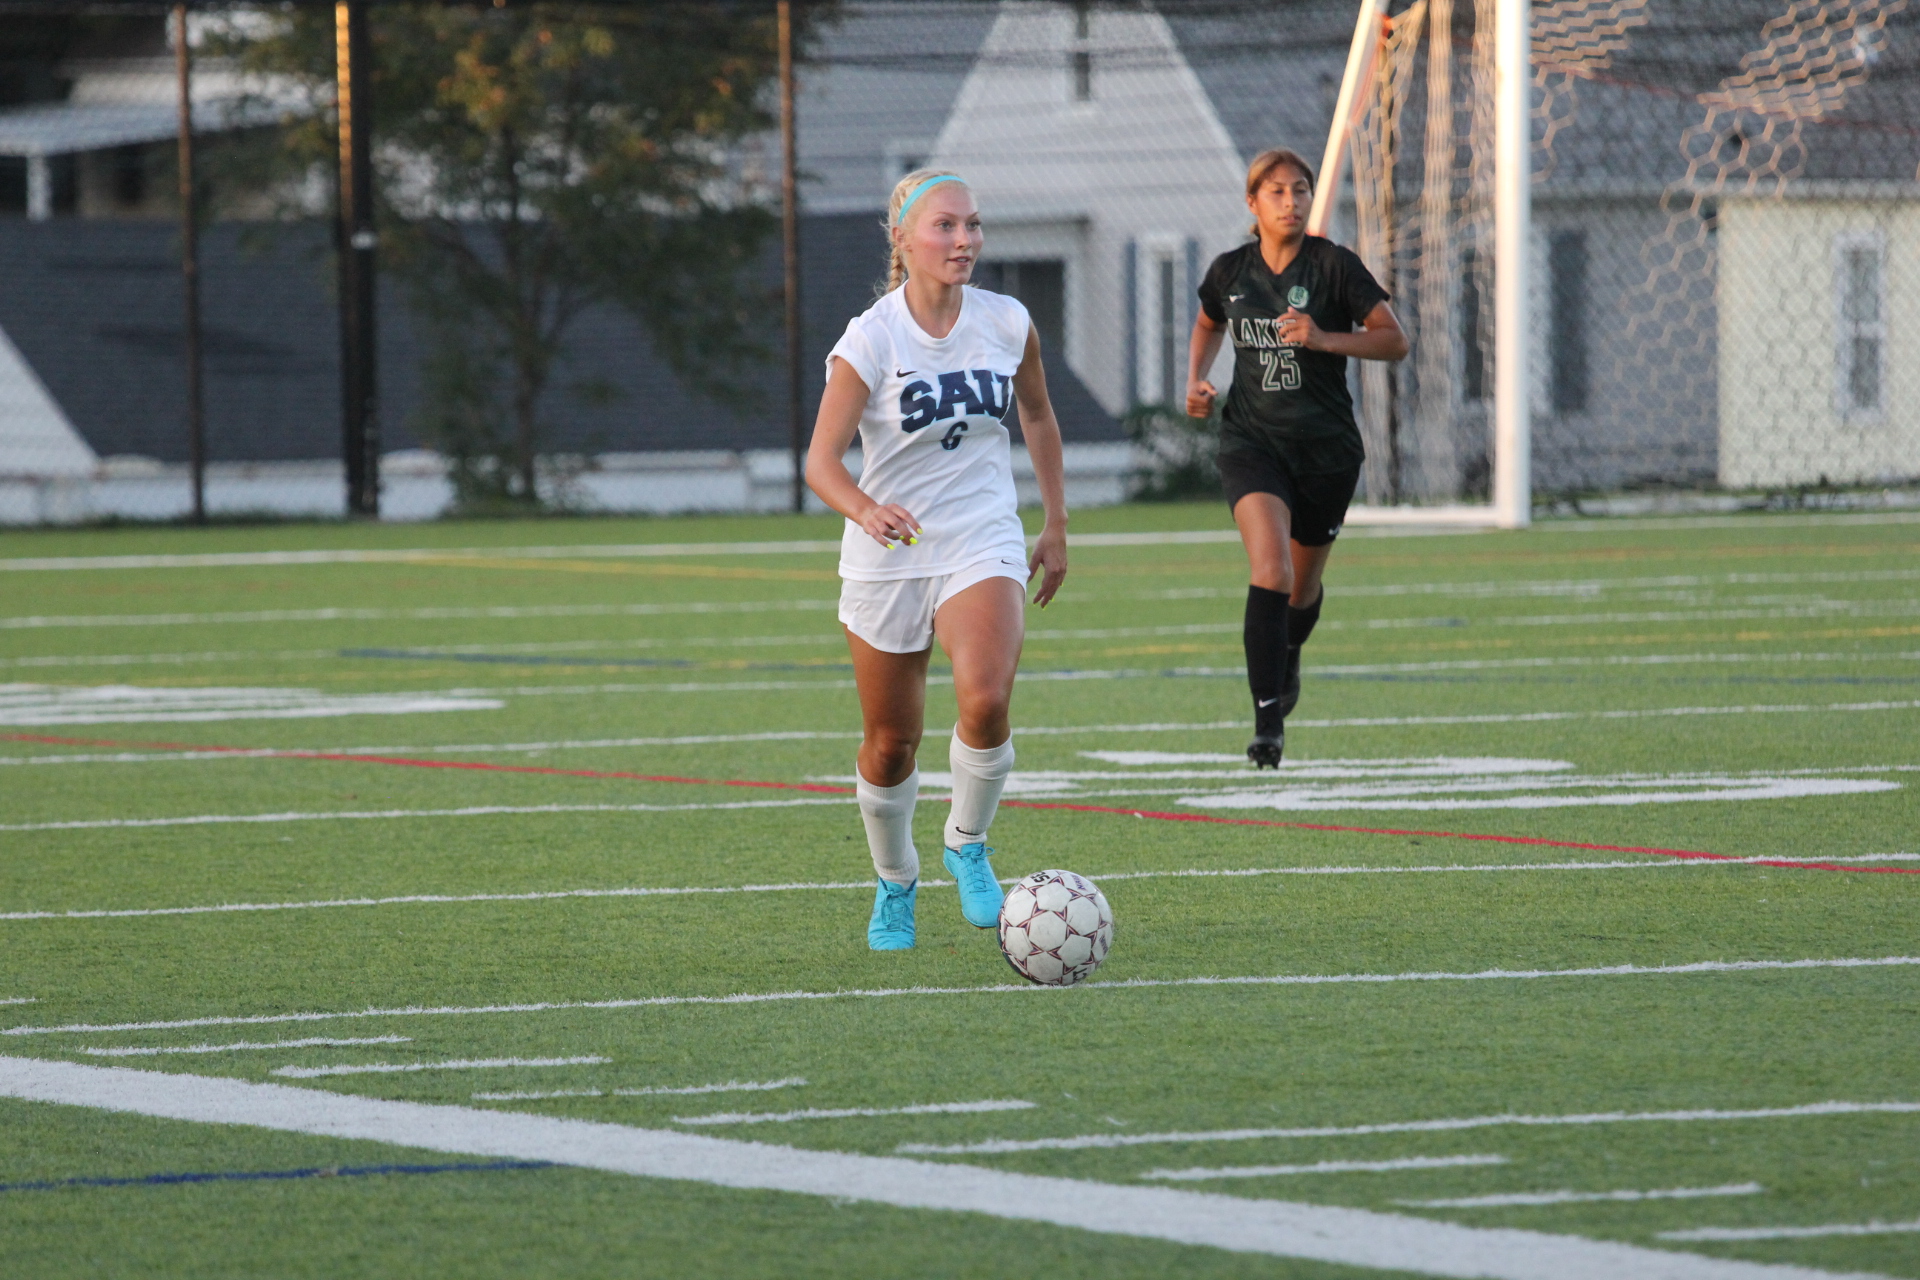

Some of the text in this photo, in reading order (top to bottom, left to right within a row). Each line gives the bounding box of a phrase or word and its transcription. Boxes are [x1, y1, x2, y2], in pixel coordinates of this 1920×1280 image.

[1227, 318, 1304, 348] LAKE
[1259, 349, 1302, 392] 25
[900, 369, 1010, 434] SAU
[940, 421, 969, 451] 6
